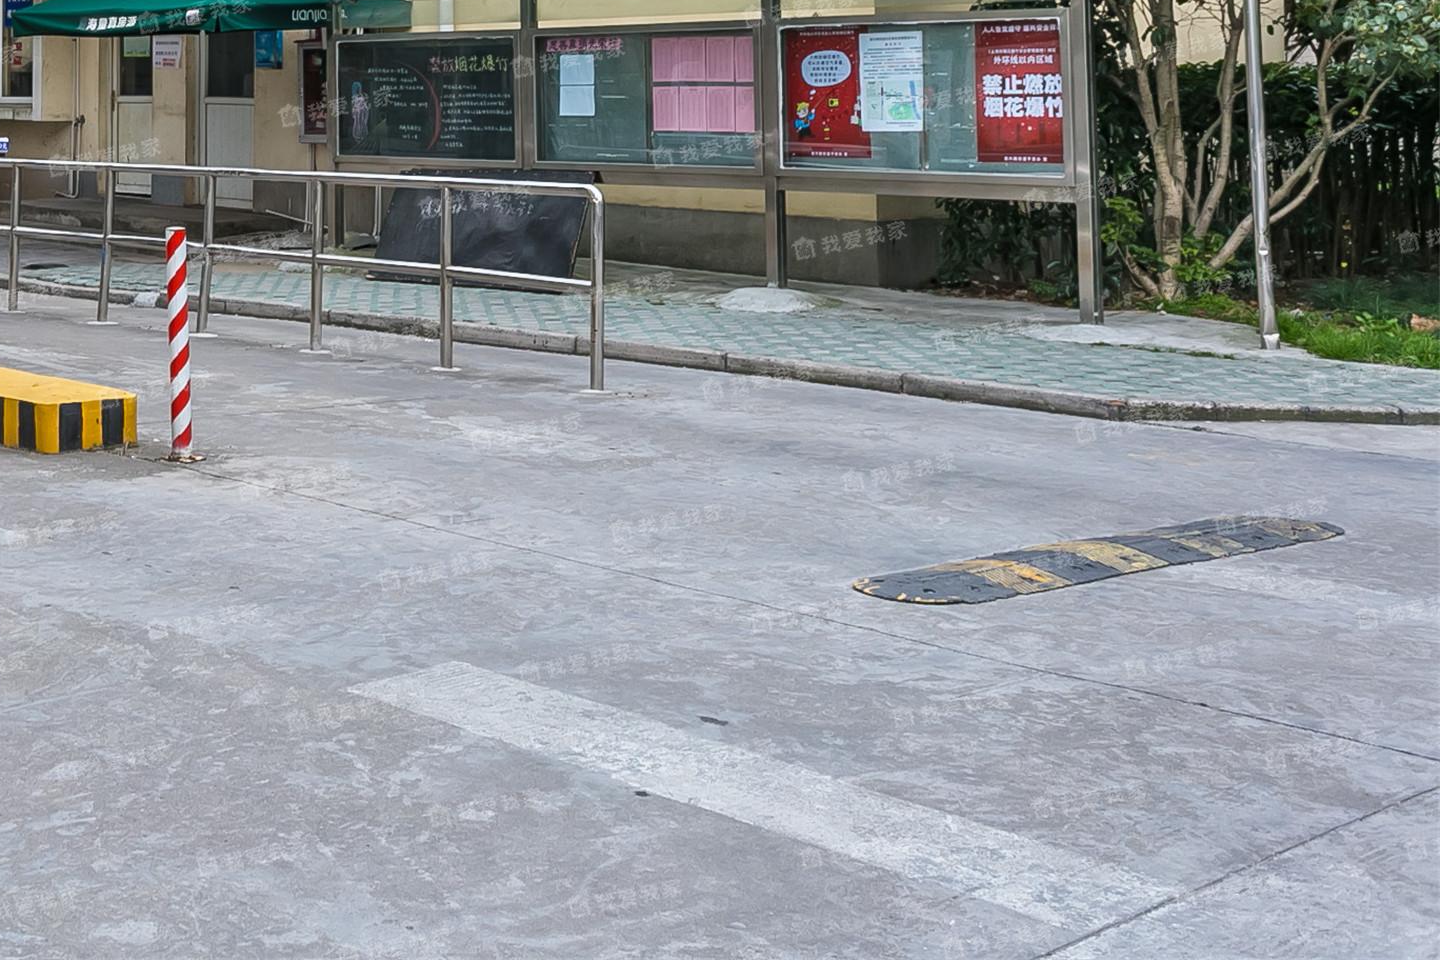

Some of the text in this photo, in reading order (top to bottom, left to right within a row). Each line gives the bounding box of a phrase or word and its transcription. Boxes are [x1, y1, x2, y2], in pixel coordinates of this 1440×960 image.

[982, 74, 1063, 95] 禁止燃放
[983, 96, 1064, 118] 烟花爆竹
